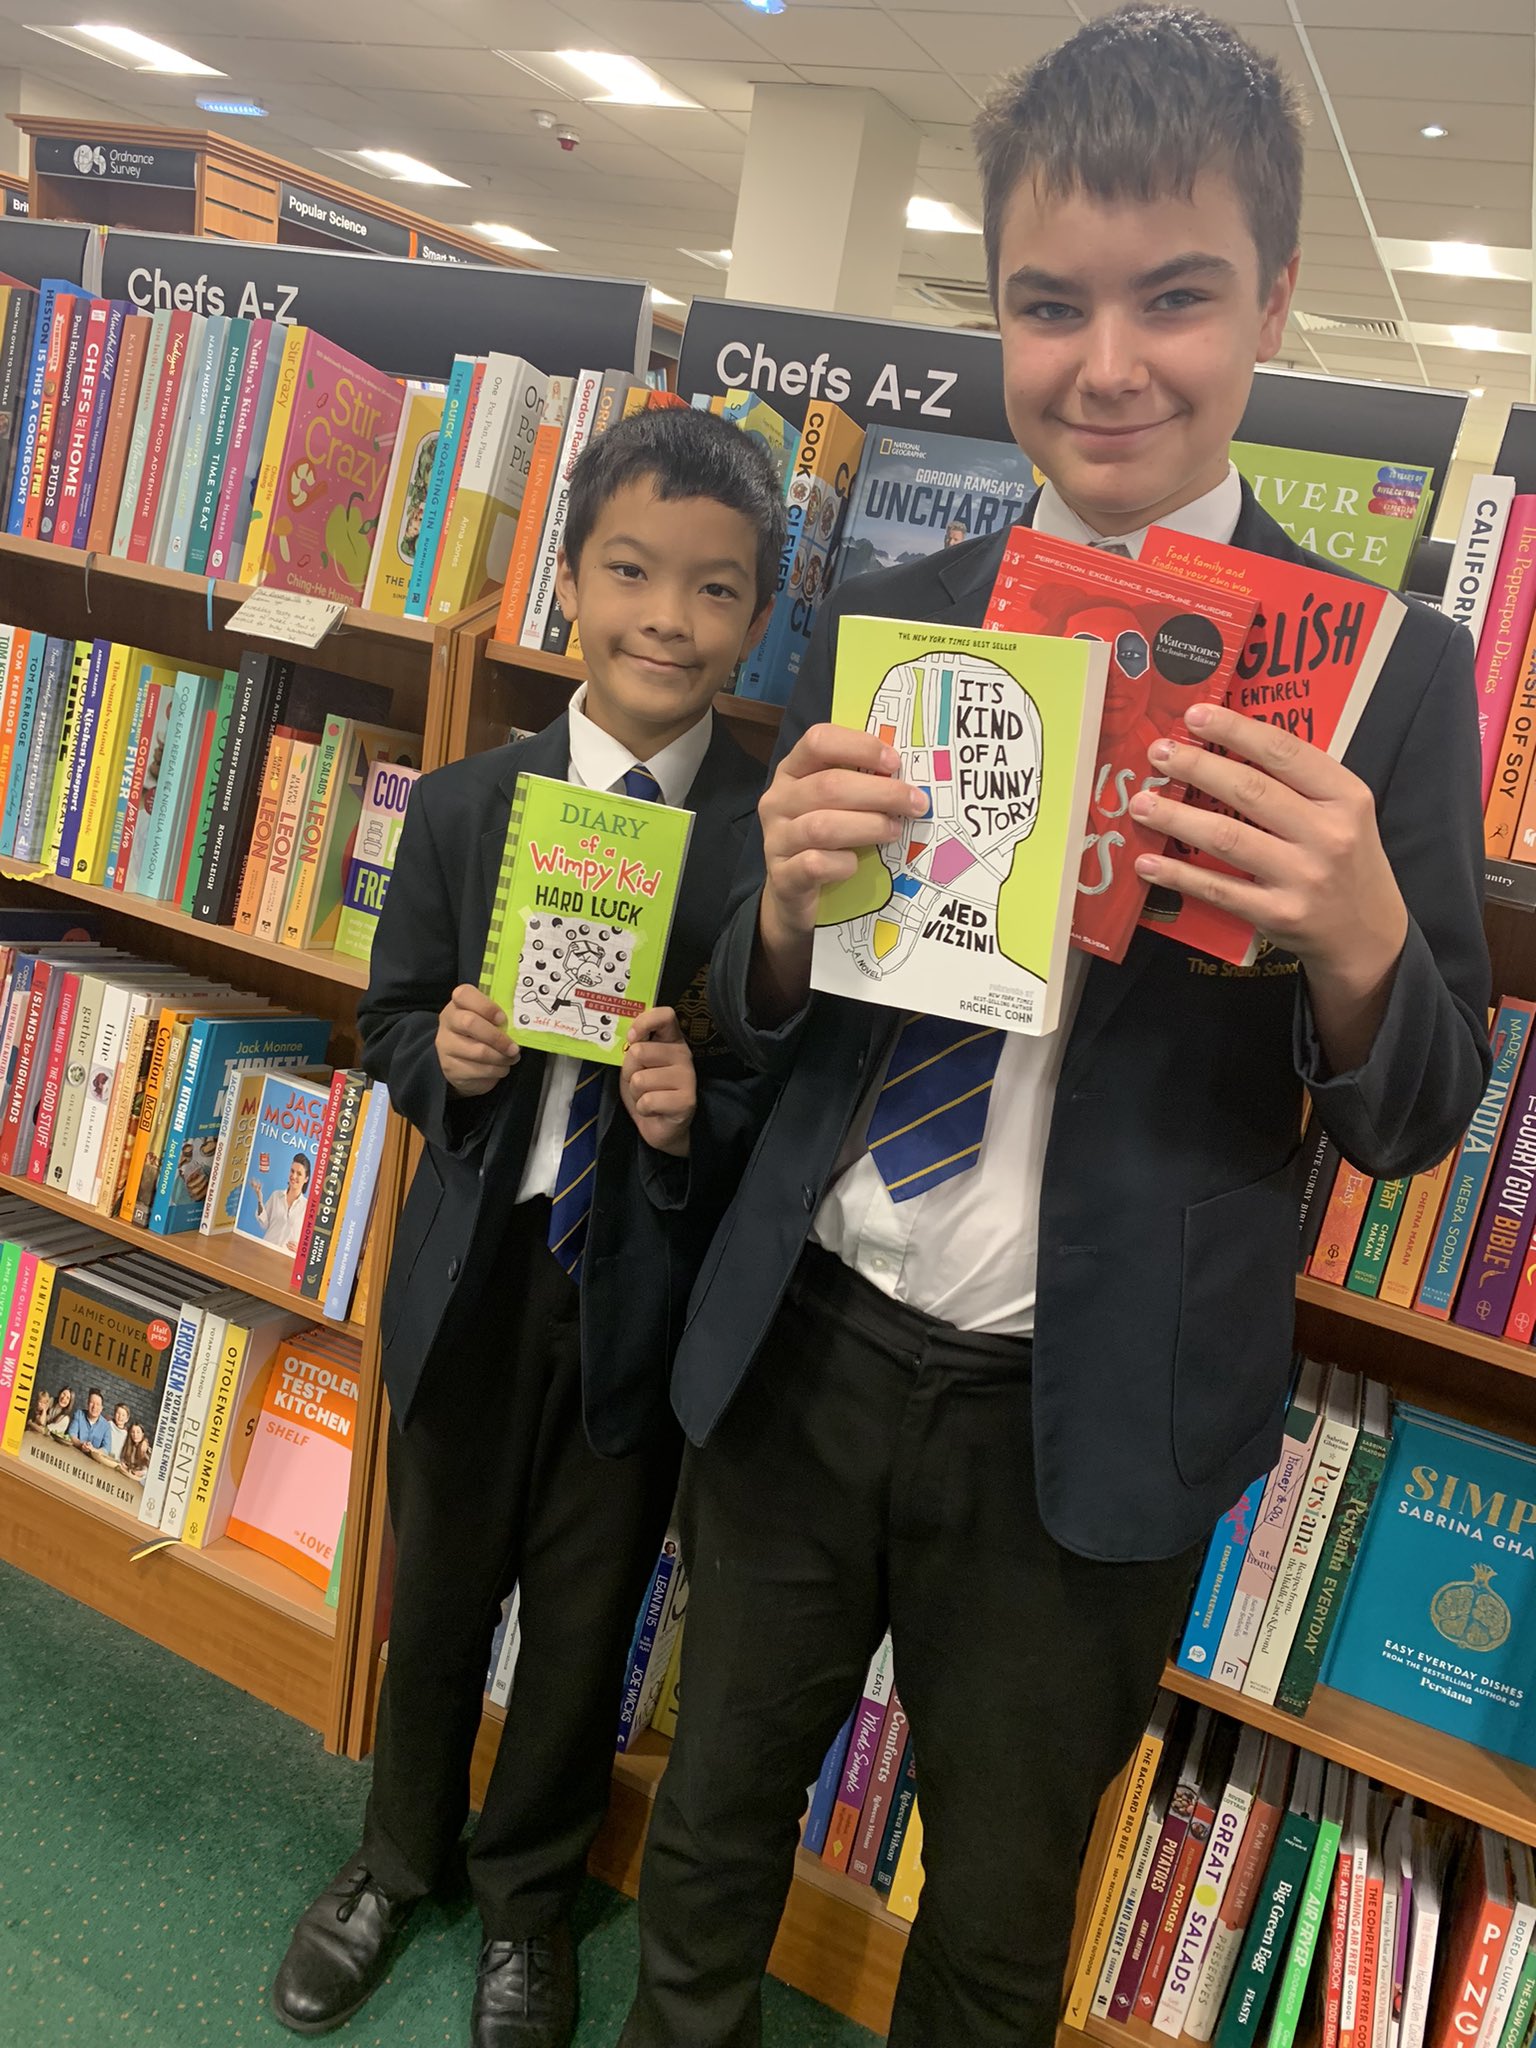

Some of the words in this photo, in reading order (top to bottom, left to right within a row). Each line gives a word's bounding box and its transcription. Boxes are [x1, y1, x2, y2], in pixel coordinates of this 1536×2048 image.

[109, 150, 154, 165] Ordnance
[110, 162, 141, 178] Survey
[289, 196, 327, 221] Popular
[329, 211, 367, 235] Science
[127, 268, 225, 316] Chefs
[237, 281, 299, 324] A-Z
[79, 344, 99, 412] CHEFS
[716, 342, 851, 402] Chefs
[866, 364, 958, 418] A-Z
[75, 419, 87, 427] AT
[331, 378, 381, 439] Stir
[575, 379, 595, 428] Gordon
[64, 434, 85, 497] HOME
[305, 416, 389, 502] Crazy
[562, 431, 583, 482] Ramsay
[915, 468, 962, 489] GORDON
[963, 475, 1025, 498] RAMSAY'S
[554, 489, 570, 526] Quick
[548, 529, 561, 554] and
[1151, 556, 1184, 575] finding
[1186, 567, 1208, 581] your
[1209, 576, 1230, 588] own
[1231, 581, 1253, 595] way
[1166, 545, 1191, 565] Food,
[1192, 555, 1224, 576] family
[1226, 567, 1246, 579] and
[534, 556, 555, 615] Delicious
[1498, 559, 1533, 636] Pepperpot
[14, 644, 25, 669] TOM
[898, 632, 910, 640] THE
[912, 634, 927, 642] NEW
[928, 635, 946, 645] YORK
[948, 637, 970, 647] TIMES
[972, 640, 990, 648] BEST
[991, 641, 1017, 651] SELLER
[1156, 644, 1189, 662] Exclusive
[1189, 654, 1217, 667] Edition
[1159, 633, 1222, 659] Waterstones
[29, 657, 38, 680] TOM
[1484, 640, 1513, 695] Diaries
[5, 674, 21, 734] KERRIDGE
[958, 679, 1004, 704] IT'S
[1241, 680, 1310, 707] ENTIRELY
[17, 684, 33, 748] KERRIDGE
[79, 708, 94, 752] Kitchen
[956, 705, 1023, 740] KIND
[1512, 717, 1532, 747] OF
[118, 745, 138, 799] FIVER
[325, 745, 335, 760] BIG
[959, 744, 990, 764] OF
[993, 745, 1008, 767] A
[70, 754, 86, 812] Passport
[317, 760, 332, 796] SALADS
[959, 767, 1035, 800] FUNNY
[1499, 752, 1523, 799] SOY
[251, 797, 277, 860] LEON
[300, 800, 327, 864] LEON
[560, 802, 649, 840] DIARY
[963, 798, 1036, 838] STORY
[269, 812, 296, 875] LEON
[580, 834, 600, 853] of
[604, 847, 616, 859] a
[529, 841, 616, 892] Wimpy
[616, 858, 662, 898] Kid
[535, 885, 584, 913] HARD
[591, 895, 643, 927] LUCK
[938, 899, 988, 928] NED
[854, 951, 861, 960] A
[921, 920, 995, 955] VIZZINI
[857, 959, 881, 979] NOVEL
[1187, 958, 1217, 976] The
[1262, 959, 1299, 977] School
[576, 990, 643, 1009] INTERNATIONAL
[588, 1003, 640, 1016] BESTSELLE
[960, 1000, 1001, 1018] RACHEL
[1005, 1009, 1033, 1023] COHN
[76, 1006, 92, 1056] gather
[100, 1022, 117, 1063] time
[533, 1015, 550, 1027] Jeff
[553, 1020, 580, 1035] Kinney
[1505, 1018, 1522, 1059] MADE
[185, 1038, 203, 1084] THRIFTY
[236, 1041, 260, 1055] Jack
[262, 1040, 304, 1053] Monroe
[1496, 1058, 1513, 1073] IN
[173, 1086, 192, 1132] KITCHEN
[339, 1087, 356, 1139] MOWGLI
[1463, 1078, 1510, 1154] INDIA
[168, 1139, 179, 1162] Jack
[260, 1122, 280, 1139] TIN
[281, 1130, 308, 1150] CAN
[160, 1161, 174, 1196] Monroe
[330, 1143, 345, 1187] STREET
[321, 1189, 336, 1224] FOOD
[1412, 1191, 1429, 1230] CHETNA
[1451, 1174, 1474, 1223] MEERA
[1363, 1222, 1379, 1258] MAKAN
[1372, 1223, 1389, 1262] CHETNA
[1402, 1231, 1417, 1266] MAKAN
[1436, 1226, 1460, 1275] SODHA
[37, 1277, 49, 1314] JAMIE
[27, 1320, 41, 1358] COOKS
[71, 1303, 106, 1325] JAMIE
[106, 1318, 148, 1343] OLIVER
[150, 1333, 169, 1345] price
[152, 1324, 169, 1336] Half
[59, 1316, 153, 1380] TOGETHER
[167, 1318, 197, 1393] JERUSALEM
[14, 1363, 35, 1415] ITALY
[166, 1390, 174, 1410] SAMI
[206, 1346, 238, 1444] OTTOLENGHI
[282, 1372, 327, 1402] TEST
[171, 1394, 183, 1424] YOTAM
[273, 1390, 351, 1436] KITCHEN
[155, 1411, 170, 1448] TAMIMI
[265, 1421, 310, 1448] SHELF
[157, 1425, 177, 1482] OTTOLENGHI
[169, 1417, 201, 1503] PLENTY
[30, 1446, 71, 1474] MEMORABLE
[72, 1467, 94, 1486] MEALS
[96, 1479, 115, 1497] MADE
[116, 1489, 135, 1505] EASY
[196, 1450, 216, 1503] SIMPLE
[1292, 1459, 1341, 1556] Persiana
[1398, 1500, 1483, 1542] SABRINA
[300, 1532, 334, 1559] LOVE
[1328, 1497, 1368, 1572] Persiana
[1247, 1555, 1277, 1574] home
[1304, 1576, 1338, 1656] EVERYDAY
[871, 1672, 885, 1698] EATS
[1382, 1650, 1404, 1664] FROM
[1406, 1659, 1421, 1671] THE
[1422, 1666, 1472, 1691] BESTSELLING
[1473, 1686, 1507, 1703] AUTHOR
[1509, 1699, 1521, 1708] OF
[1384, 1639, 1415, 1657] EASY
[1417, 1651, 1477, 1682] EVERYDAY
[1480, 1675, 1525, 1699] DISHES
[1420, 1676, 1473, 1706] Persiana
[1205, 1813, 1238, 1883] GREAT
[1164, 1882, 1186, 1934] POTATOES
[1272, 1880, 1292, 1902] Big
[1368, 1888, 1378, 1907] THE
[1261, 1904, 1284, 1946] Green
[1363, 1907, 1377, 1965] COMPLETE
[1171, 1911, 1207, 1995] SALADS
[1199, 1935, 1225, 2005] PRESERVES
[1251, 1945, 1272, 1974] Egg
[1361, 1966, 1372, 1986] AIR
[1238, 1988, 1256, 2025] FEASTS
[1359, 1987, 1370, 2022] FRYER
